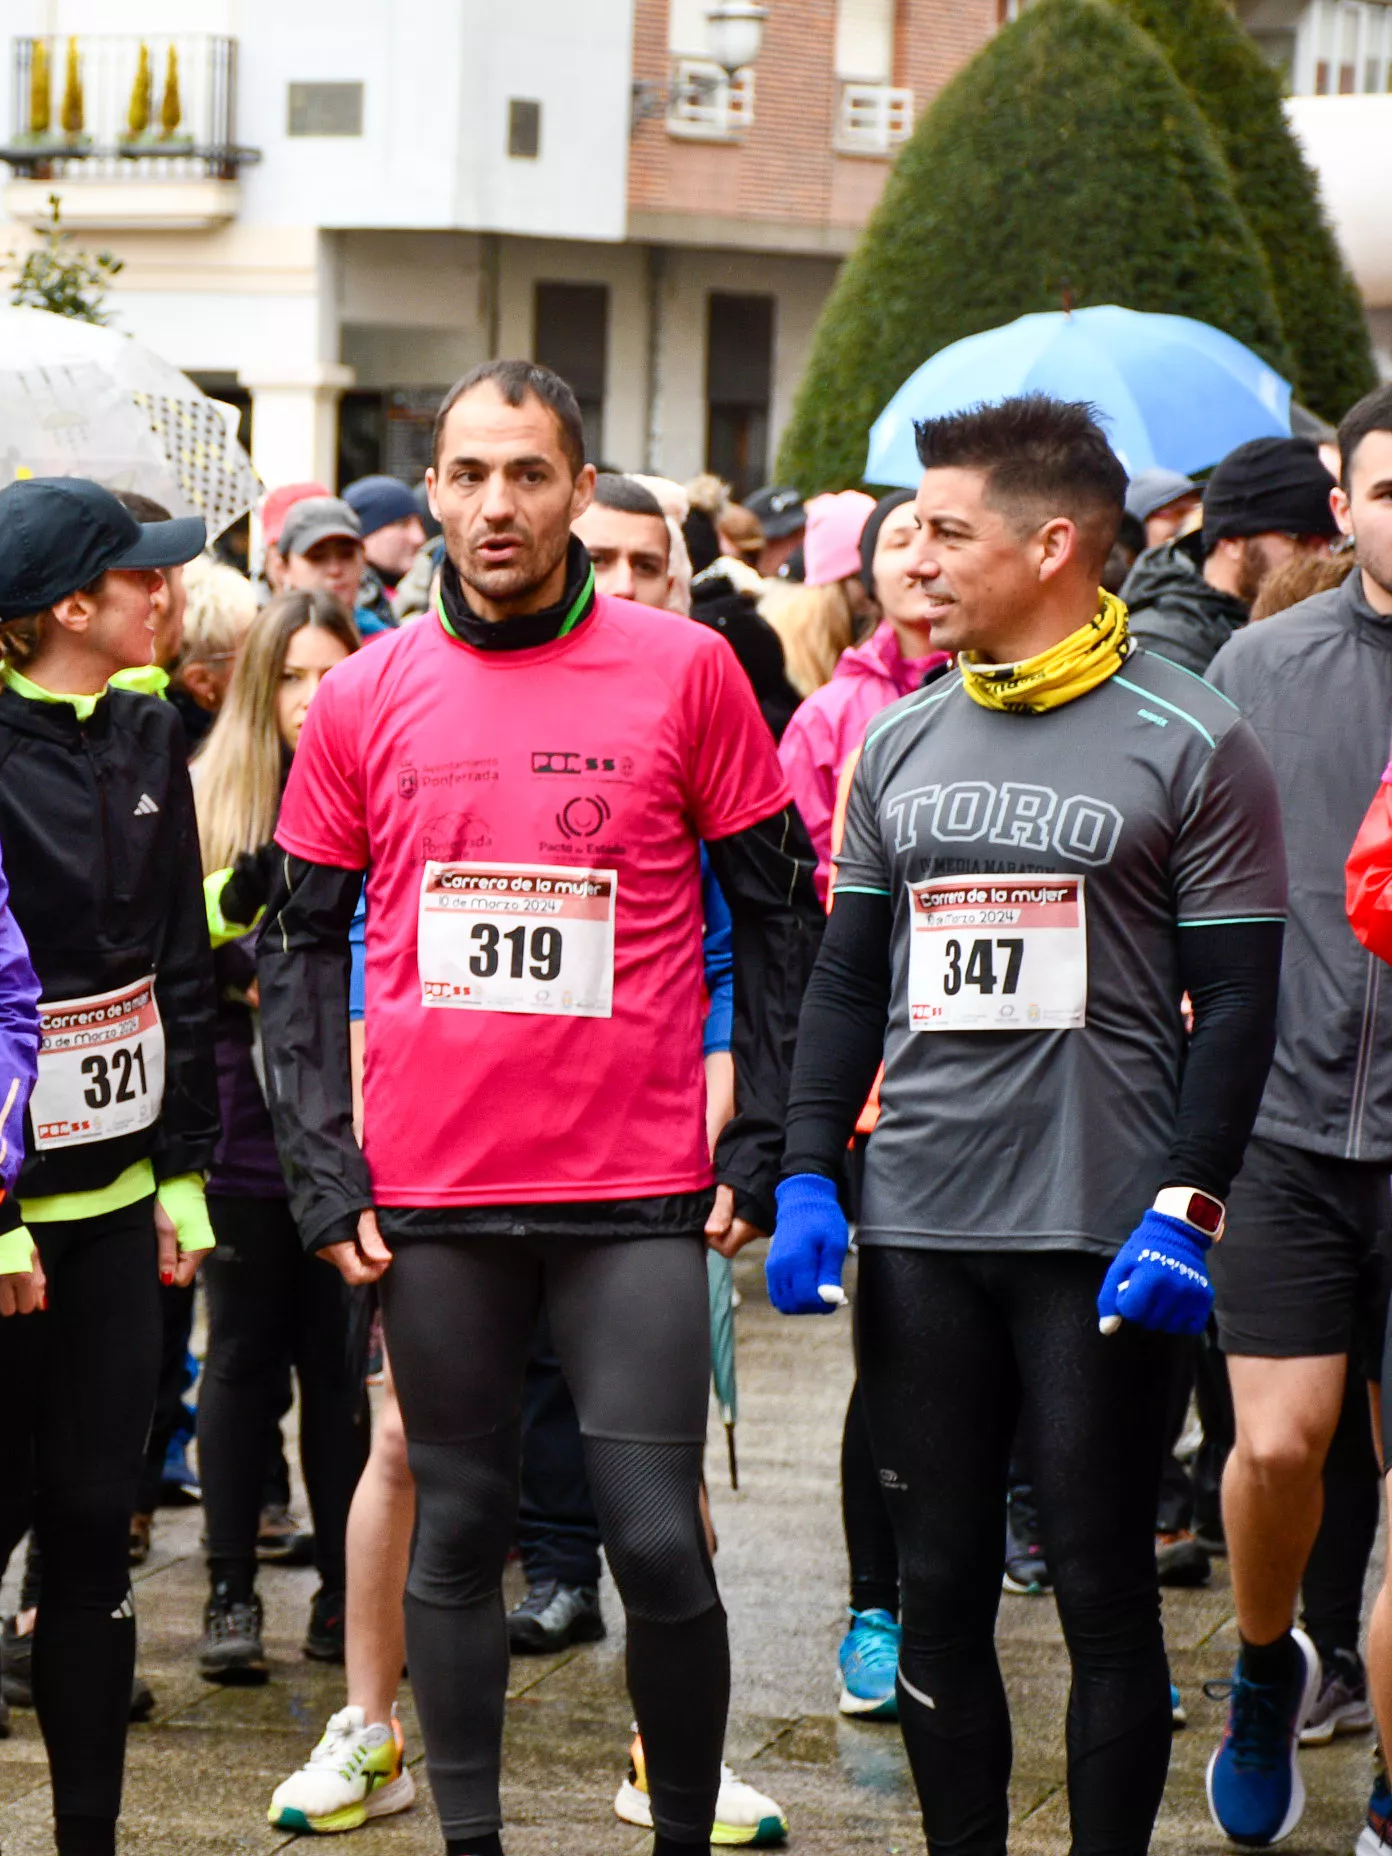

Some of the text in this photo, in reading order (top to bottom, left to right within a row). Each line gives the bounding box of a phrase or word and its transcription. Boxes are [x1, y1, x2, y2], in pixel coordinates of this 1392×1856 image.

[422, 770, 500, 789] Ponferrada
[886, 781, 1124, 866] TORO
[934, 857, 979, 874] MEDIA
[440, 872, 602, 899] Carrera de la mujer
[966, 888, 987, 903] de
[991, 888, 1008, 903] la
[1011, 887, 1068, 906] mujer
[438, 896, 557, 912] 10 de Marzo 2024
[979, 910, 1015, 924] 2024
[469, 923, 563, 981] 319
[943, 938, 1024, 996] 347
[40, 1010, 105, 1030] Carrera
[107, 1004, 122, 1018] de
[123, 1001, 132, 1014] la
[42, 1037, 52, 1049] 0
[55, 1035, 71, 1047] de
[74, 1028, 117, 1044] Marzo
[81, 1042, 148, 1109] 321
